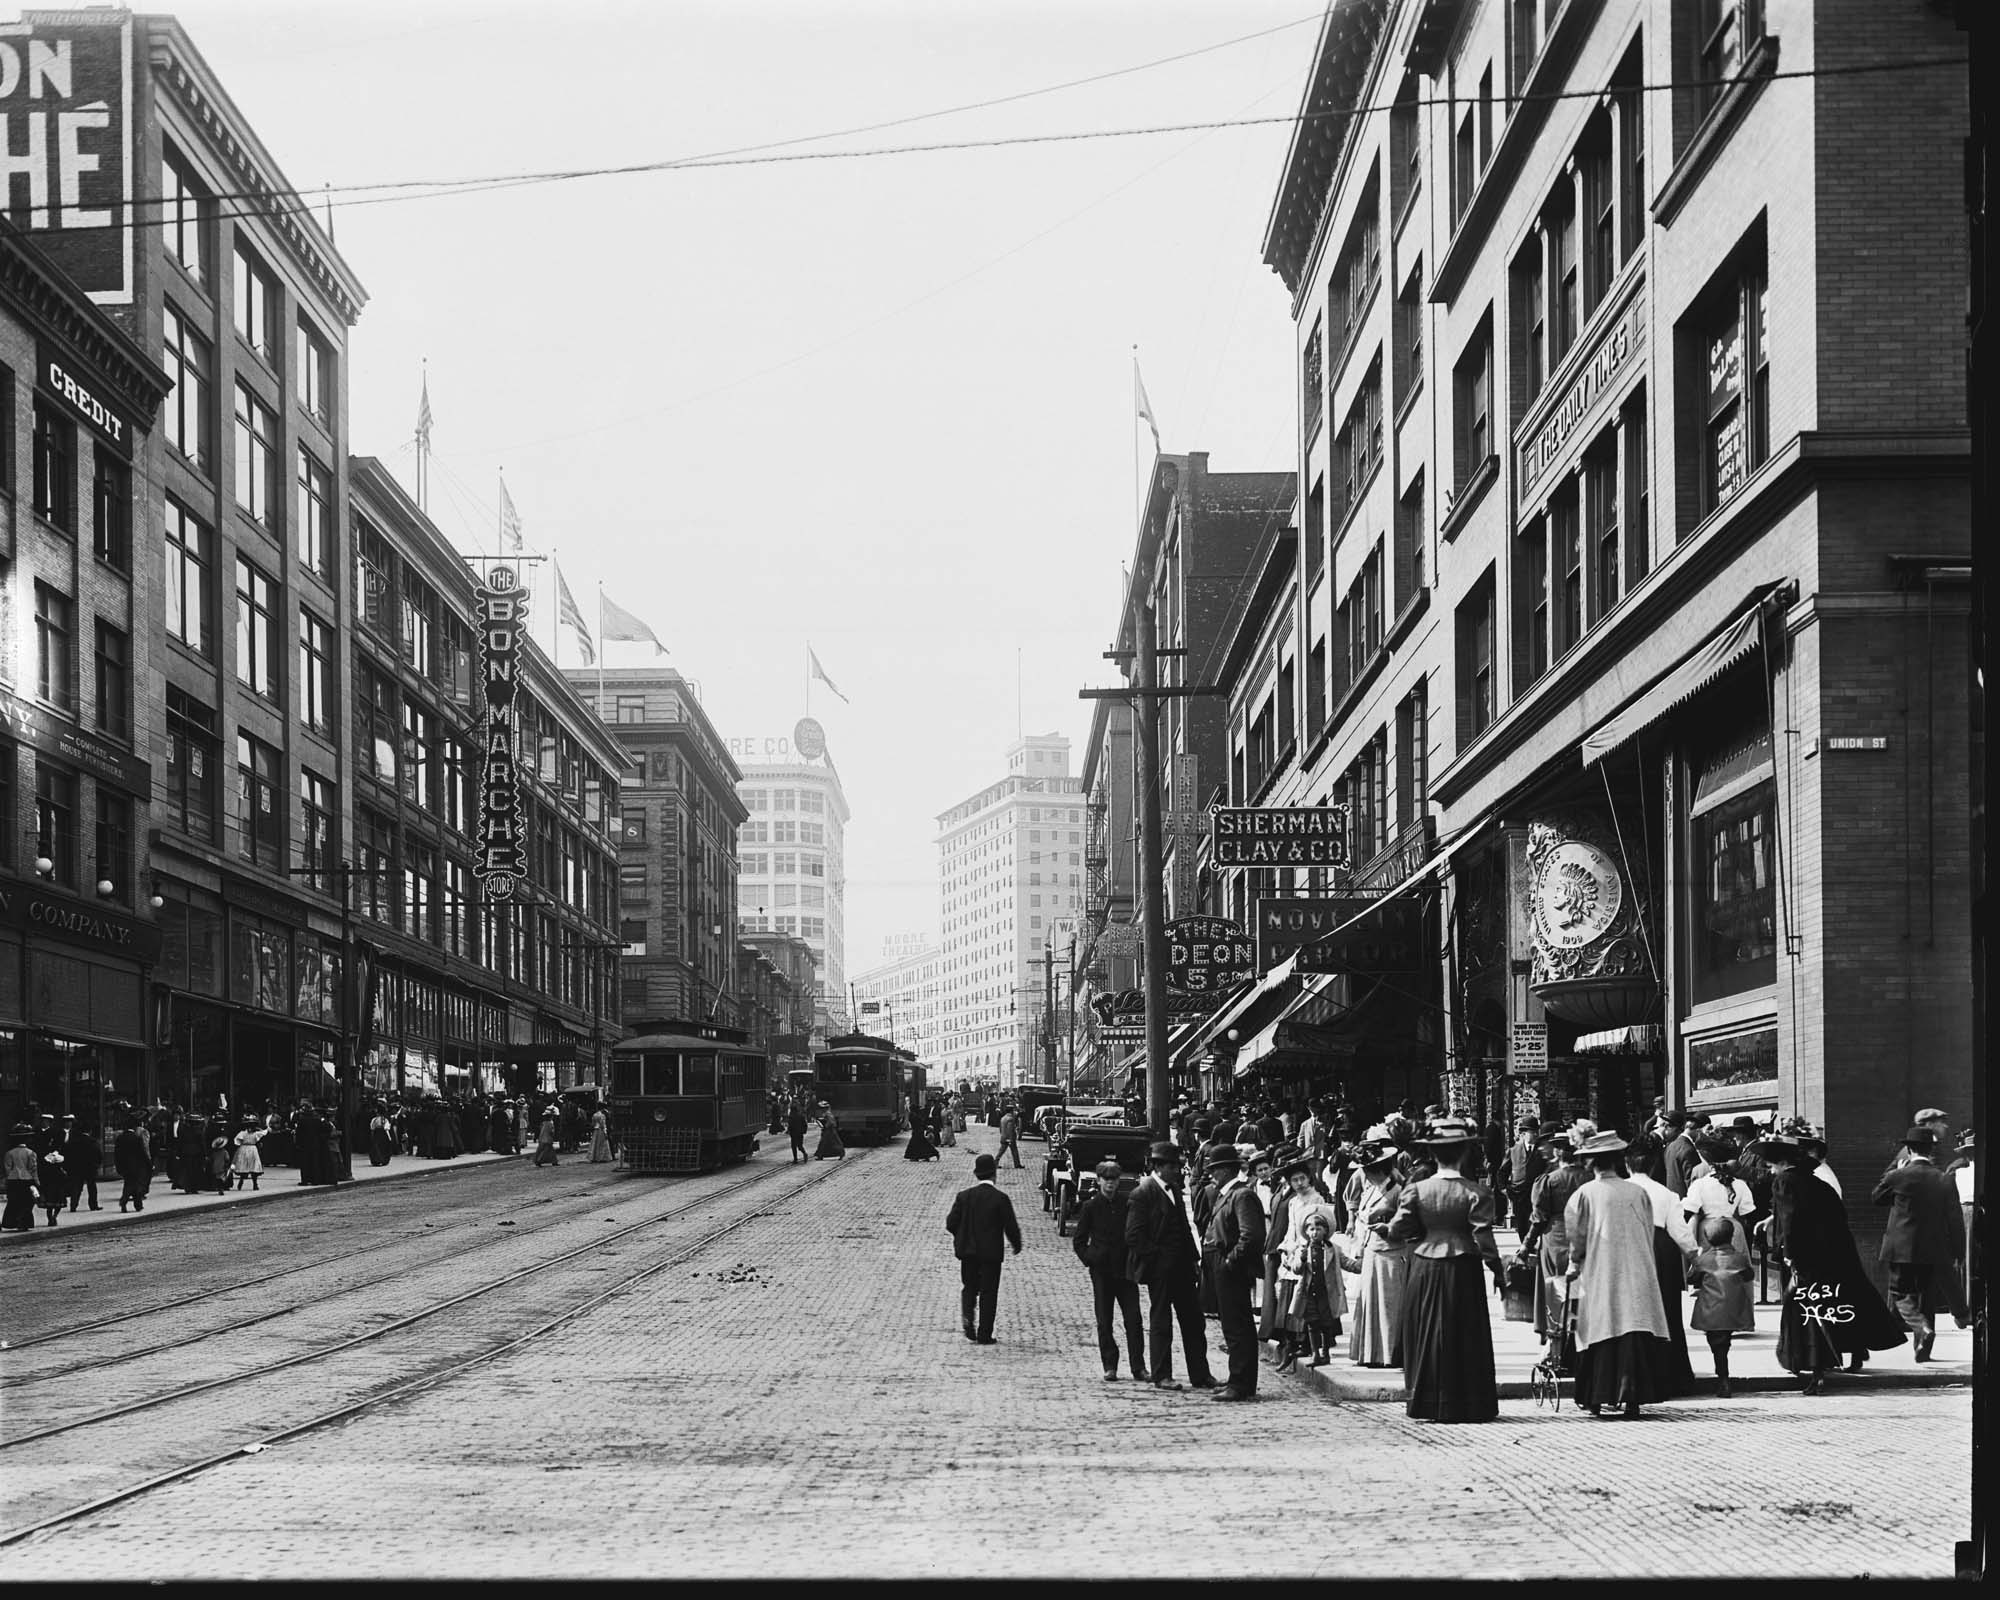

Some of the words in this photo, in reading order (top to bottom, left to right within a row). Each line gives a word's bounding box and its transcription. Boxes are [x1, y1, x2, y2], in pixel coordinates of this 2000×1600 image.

[50, 362, 122, 441] CREDIT
[1538, 417, 1560, 467] THE
[1560, 374, 1590, 441] DAILY
[1594, 322, 1628, 394] TIMES
[489, 570, 513, 590] THE
[488, 599, 514, 682] BON
[59, 740, 83, 760] HOUSE
[764, 737, 788, 755] CO
[1829, 737, 1864, 750] UNION
[1872, 737, 1887, 750] ST
[487, 703, 513, 869] MARCHE
[1218, 813, 1343, 834] SHERMAN
[1218, 840, 1284, 862] CLAY
[1287, 840, 1304, 862] &
[1310, 840, 1342, 861] CO
[1590, 852, 1606, 865] OF
[488, 877, 511, 894] STORE
[1591, 872, 1618, 932] AMERICA
[1178, 920, 1224, 939] THE
[1171, 943, 1253, 966] DEON
[1513, 1042, 1521, 1051] 3
